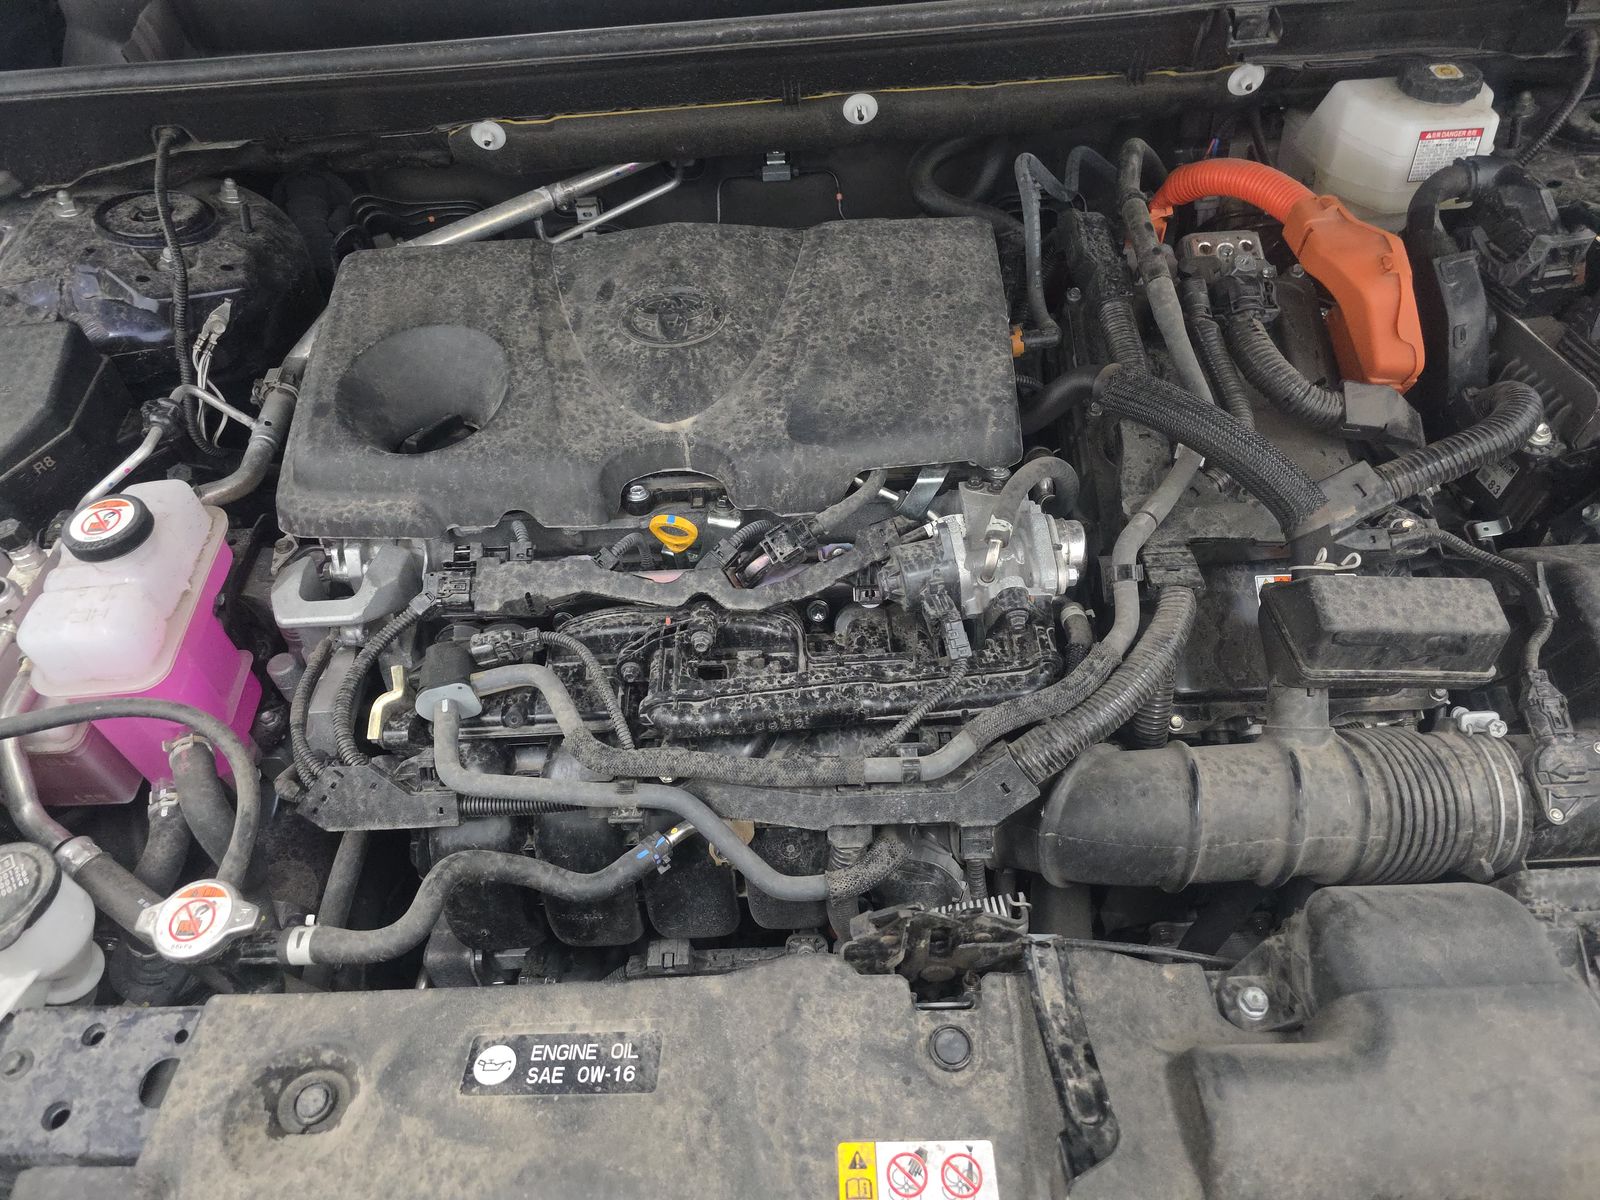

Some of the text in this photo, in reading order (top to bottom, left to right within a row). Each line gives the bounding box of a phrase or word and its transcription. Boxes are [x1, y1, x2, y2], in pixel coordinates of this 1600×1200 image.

[1441, 130, 1467, 138] DANGER
[32, 456, 57, 474] R8
[530, 1042, 639, 1061] ENGINE OIL
[526, 1065, 636, 1084] SAE 0W-16
